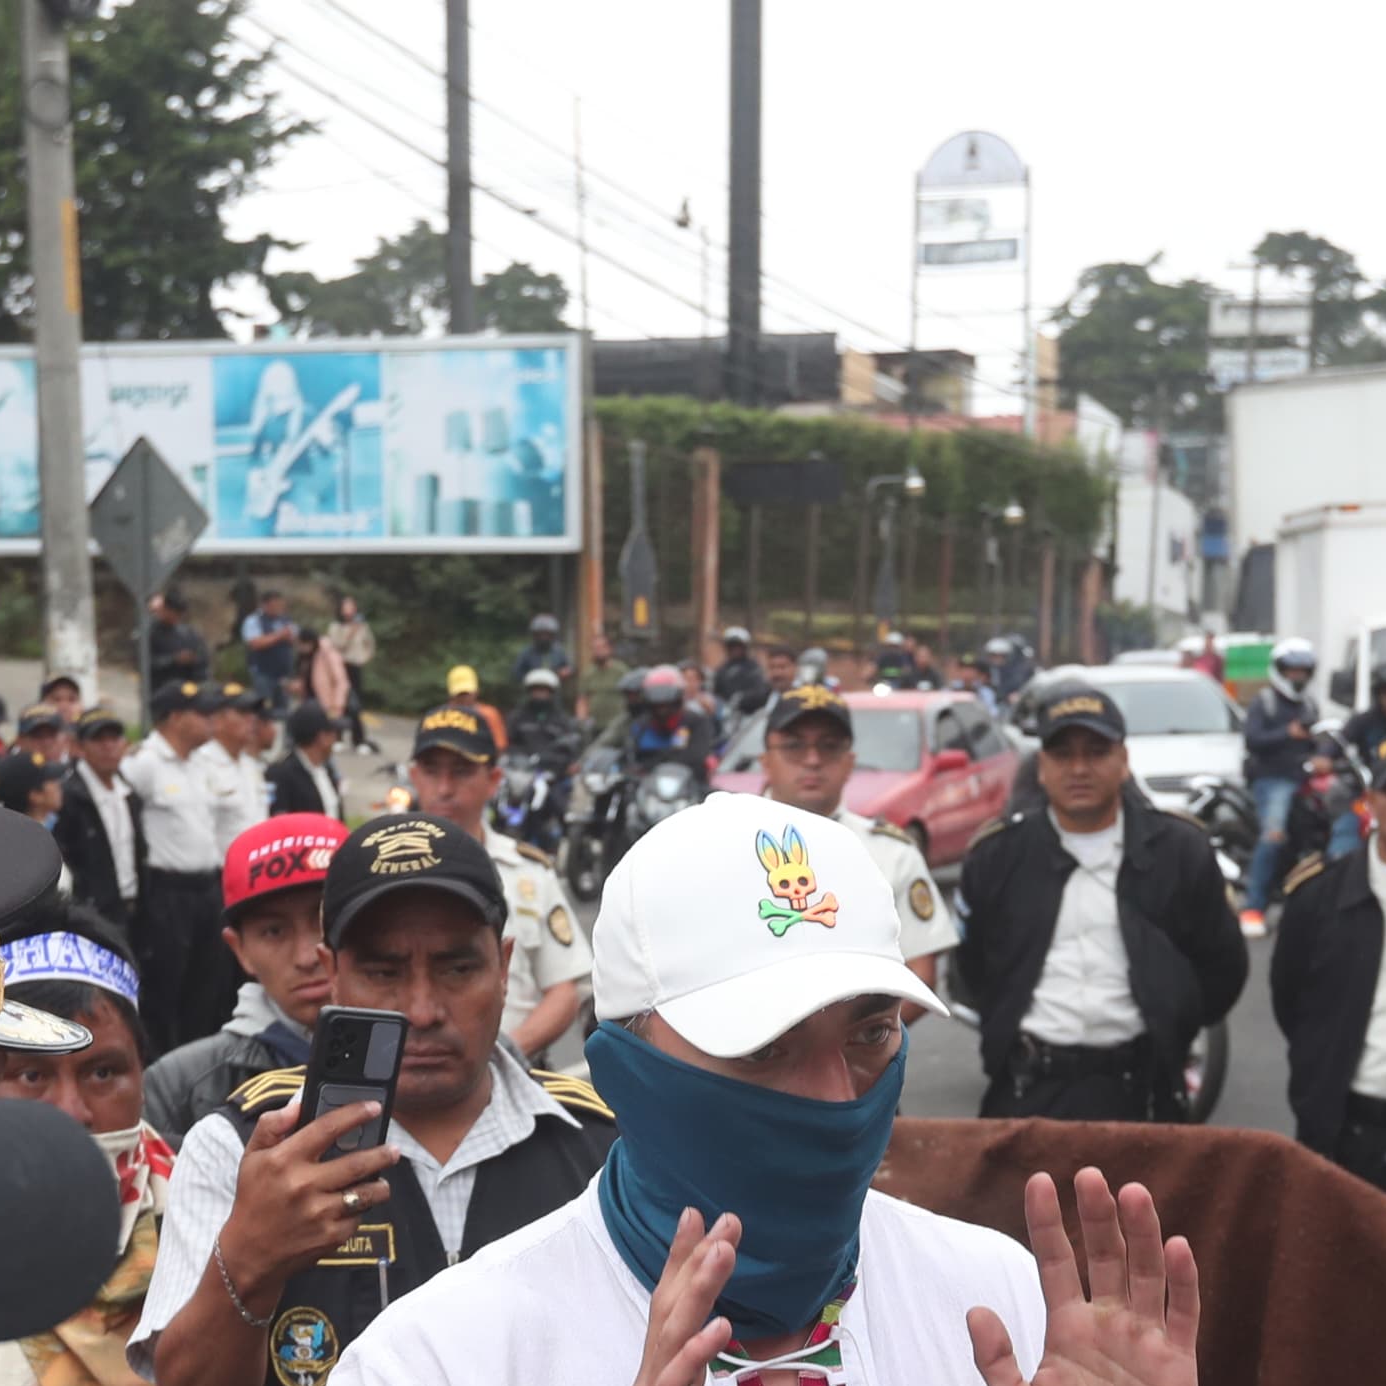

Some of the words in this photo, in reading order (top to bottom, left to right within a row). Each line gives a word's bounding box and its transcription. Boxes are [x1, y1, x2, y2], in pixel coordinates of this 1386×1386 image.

[248, 834, 339, 862] AMERICAN
[248, 847, 308, 889] FOX
[370, 854, 443, 875] GENERAL
